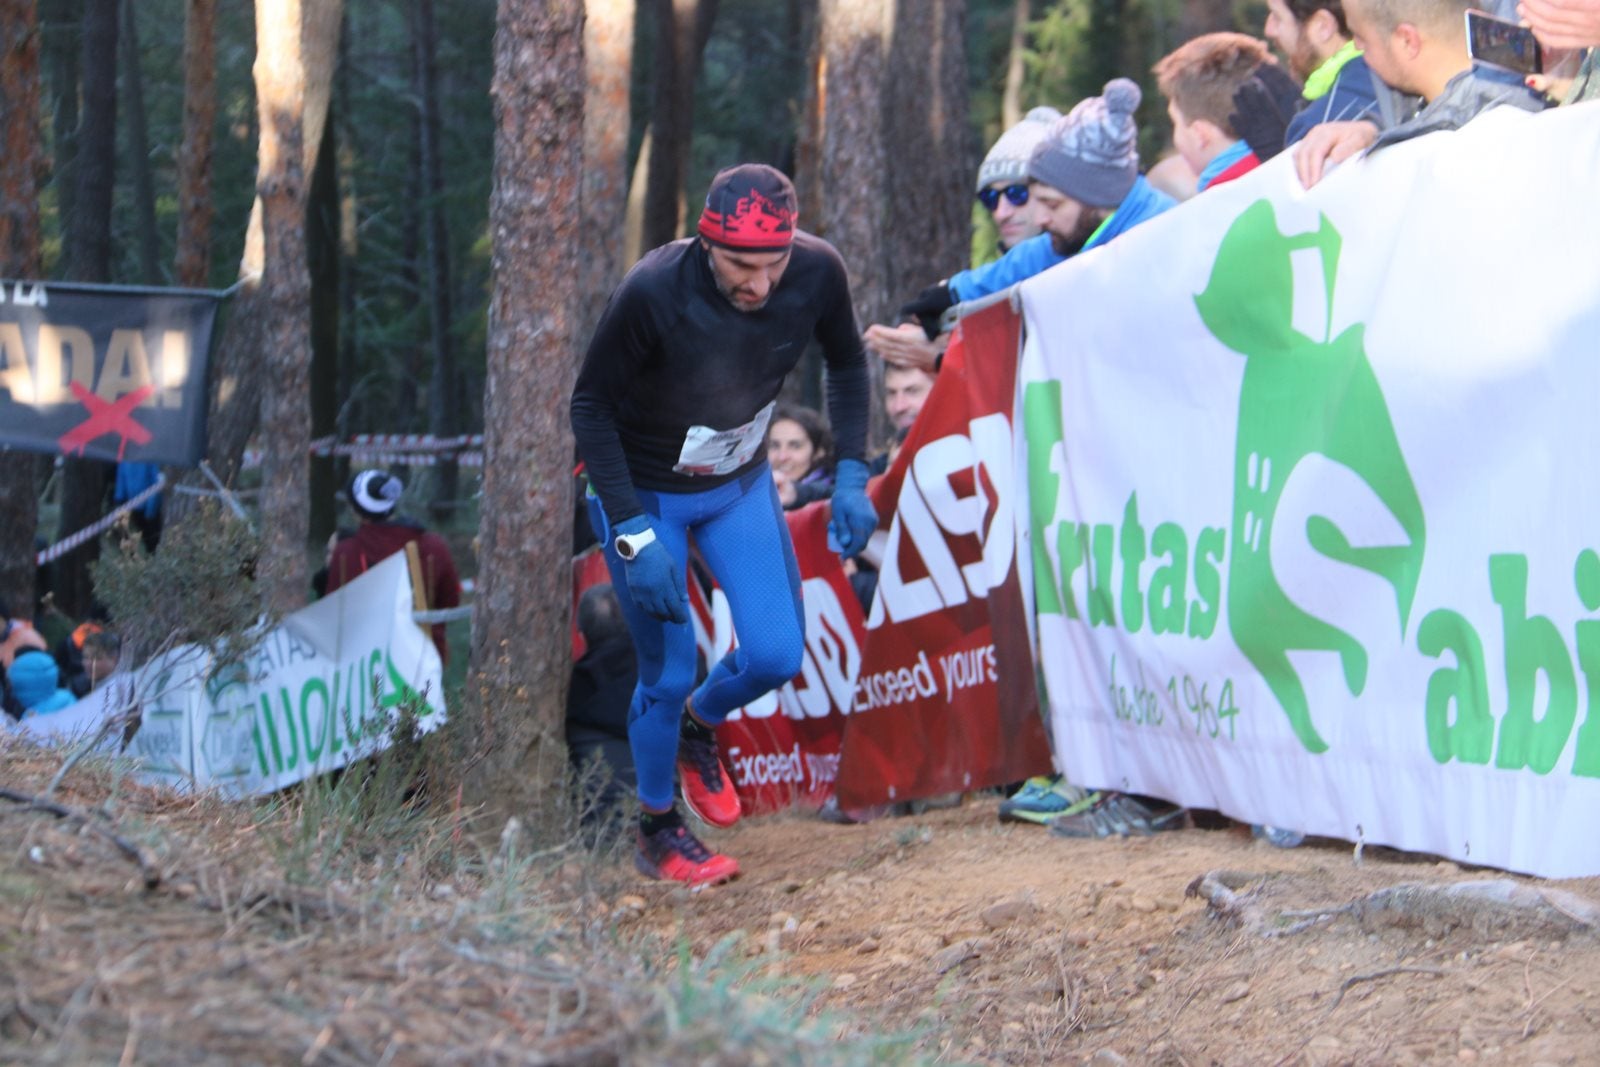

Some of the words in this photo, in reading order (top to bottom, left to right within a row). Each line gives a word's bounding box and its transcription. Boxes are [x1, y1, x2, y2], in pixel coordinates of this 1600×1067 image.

[724, 437, 743, 457] 7
[852, 650, 938, 712] Exceed
[1167, 673, 1241, 741] 1964
[728, 743, 804, 787] Exceed
